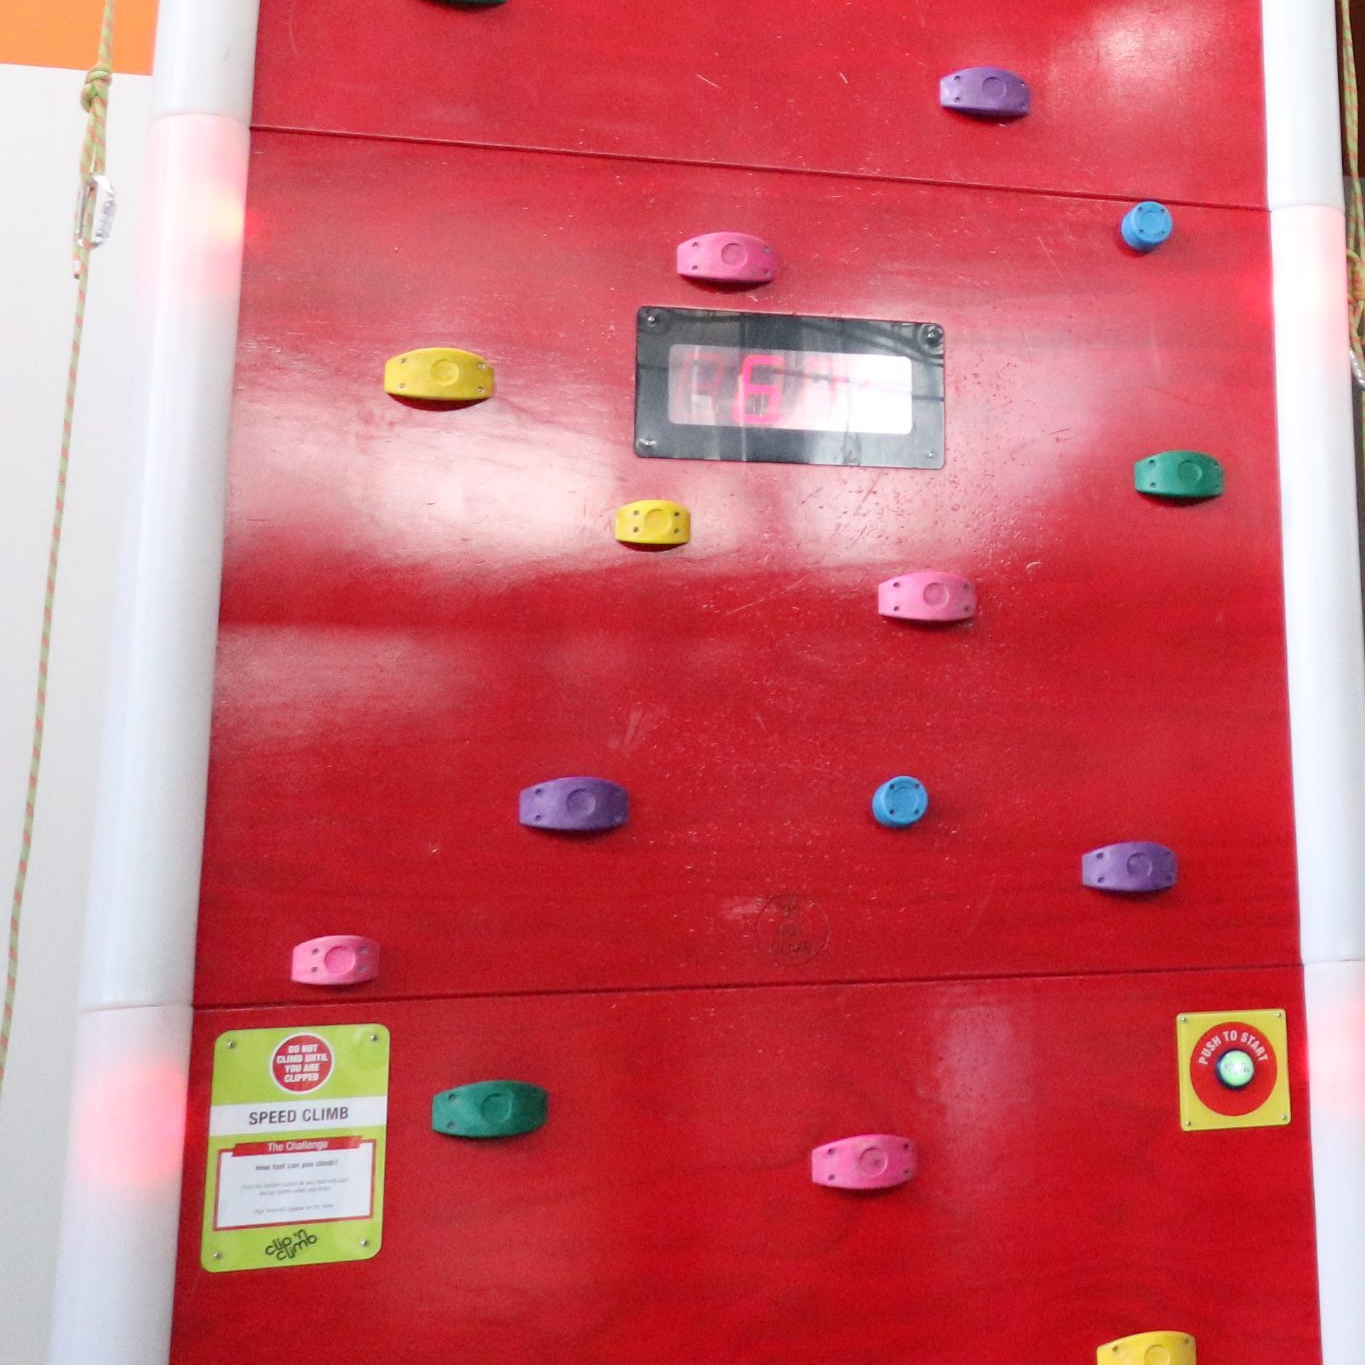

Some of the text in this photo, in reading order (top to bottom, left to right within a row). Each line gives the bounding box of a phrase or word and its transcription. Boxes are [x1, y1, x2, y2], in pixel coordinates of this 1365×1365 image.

[1198, 1030, 1269, 1066] PUSH TO START
[284, 1064, 302, 1073] YOU
[284, 1073, 319, 1083] CLIPPED
[248, 1106, 350, 1125] SPEED CLIMB
[267, 1141, 329, 1152] The Challenge
